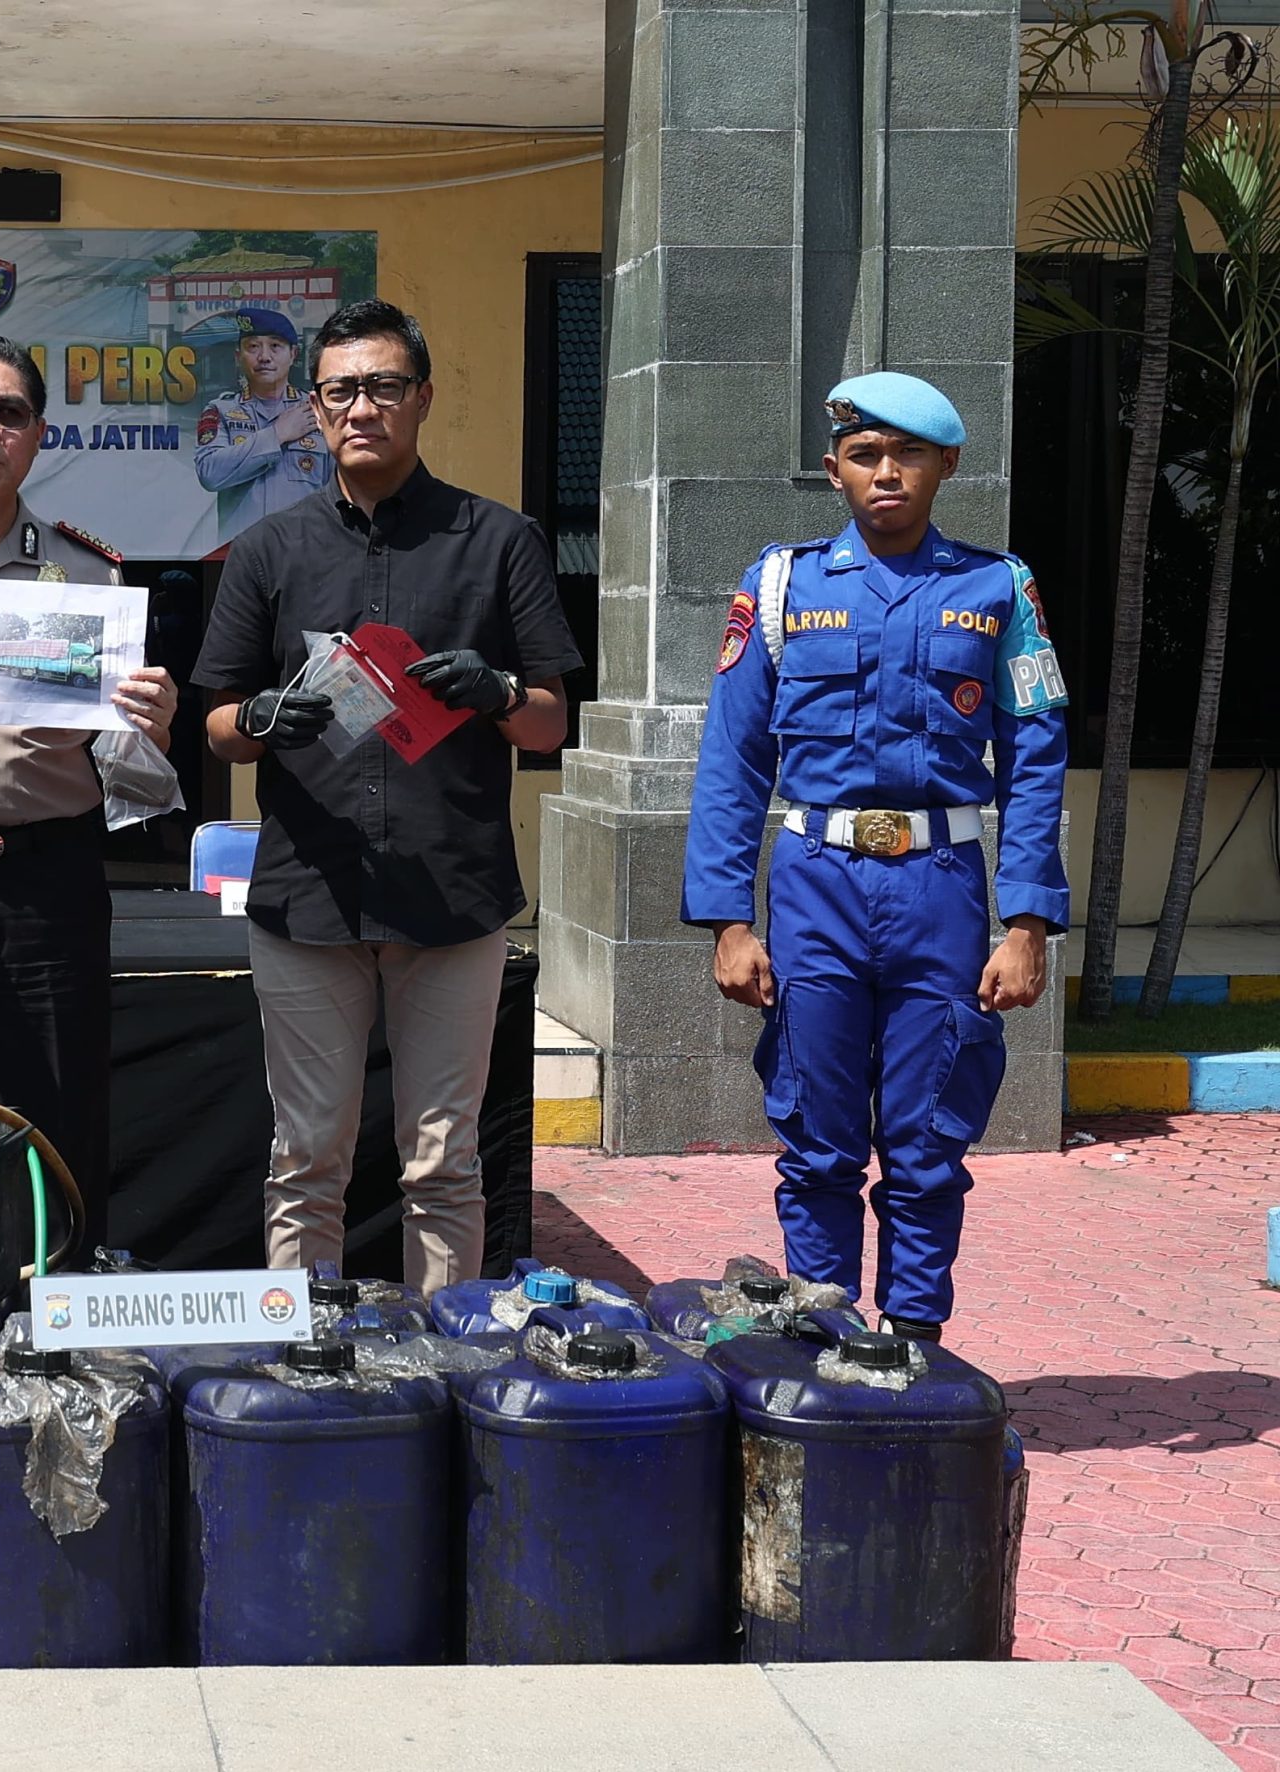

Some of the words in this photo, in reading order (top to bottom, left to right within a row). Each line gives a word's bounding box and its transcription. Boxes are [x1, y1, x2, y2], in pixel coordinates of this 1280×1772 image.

[65, 345, 198, 404] PERS
[89, 424, 179, 450] JATIM
[786, 610, 849, 633] M.RYAN
[942, 609, 1000, 638] POLRI
[86, 1294, 175, 1328] BARANG
[182, 1291, 247, 1325] BUKTI
